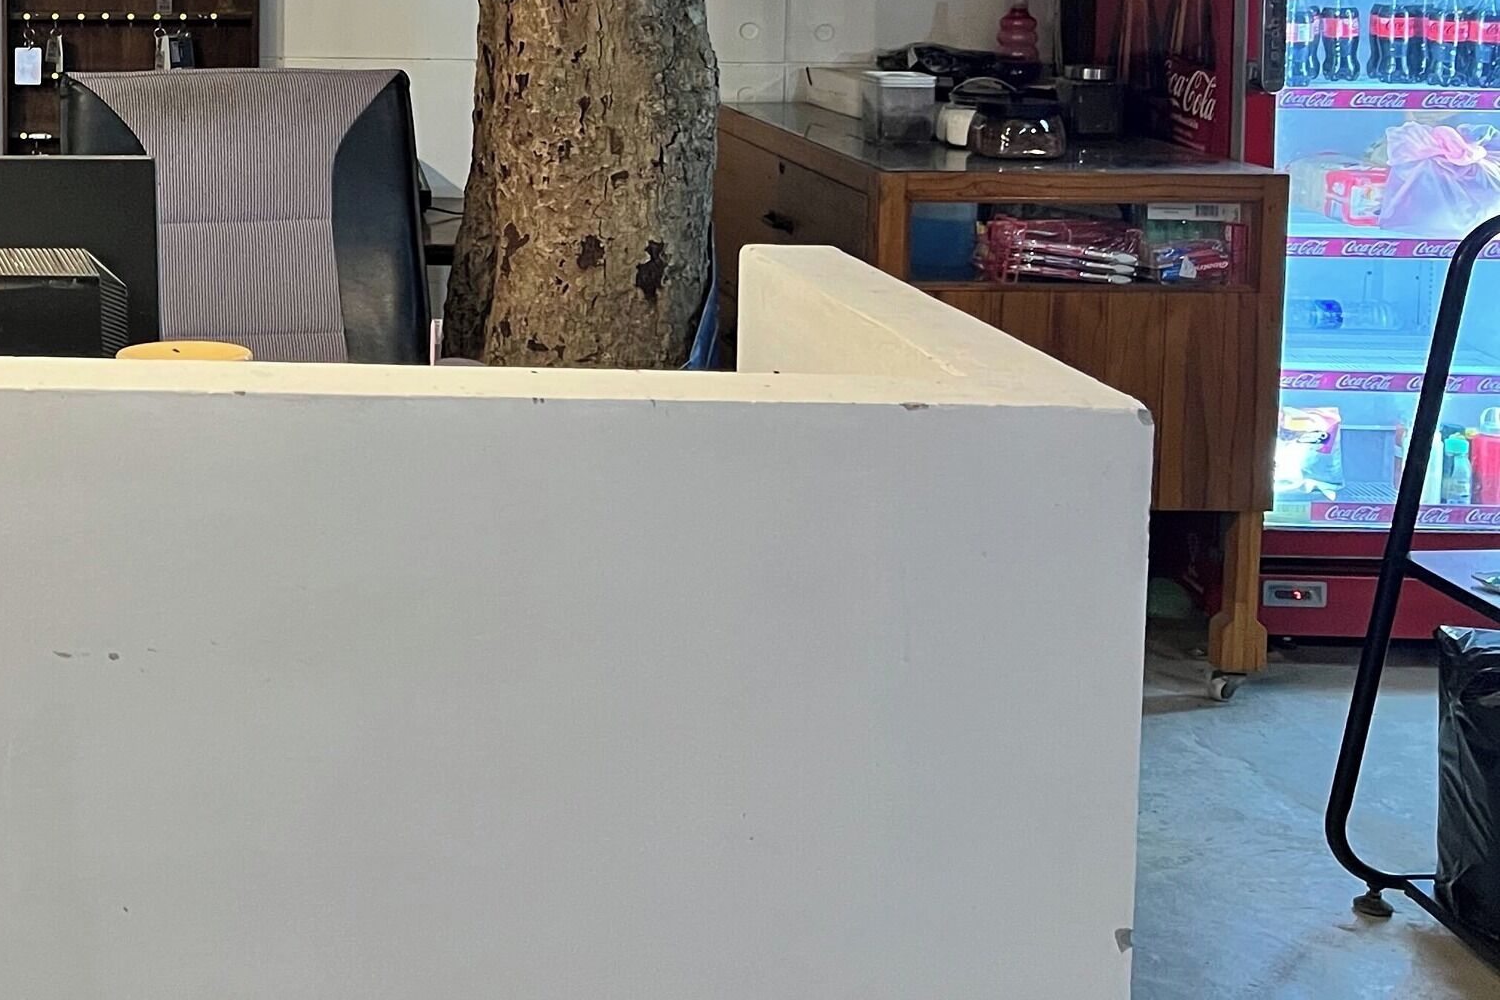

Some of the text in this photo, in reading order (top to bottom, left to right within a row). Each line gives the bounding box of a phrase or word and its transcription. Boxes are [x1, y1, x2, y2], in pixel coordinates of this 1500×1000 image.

[1280, 91, 1482, 107] Coca-Cola Coca-Cola Coca-Cola
[1341, 240, 1399, 256] Coca-Cola
[1336, 374, 1394, 390] Coca-Cola
[1325, 505, 1380, 521] Coca-Cola
